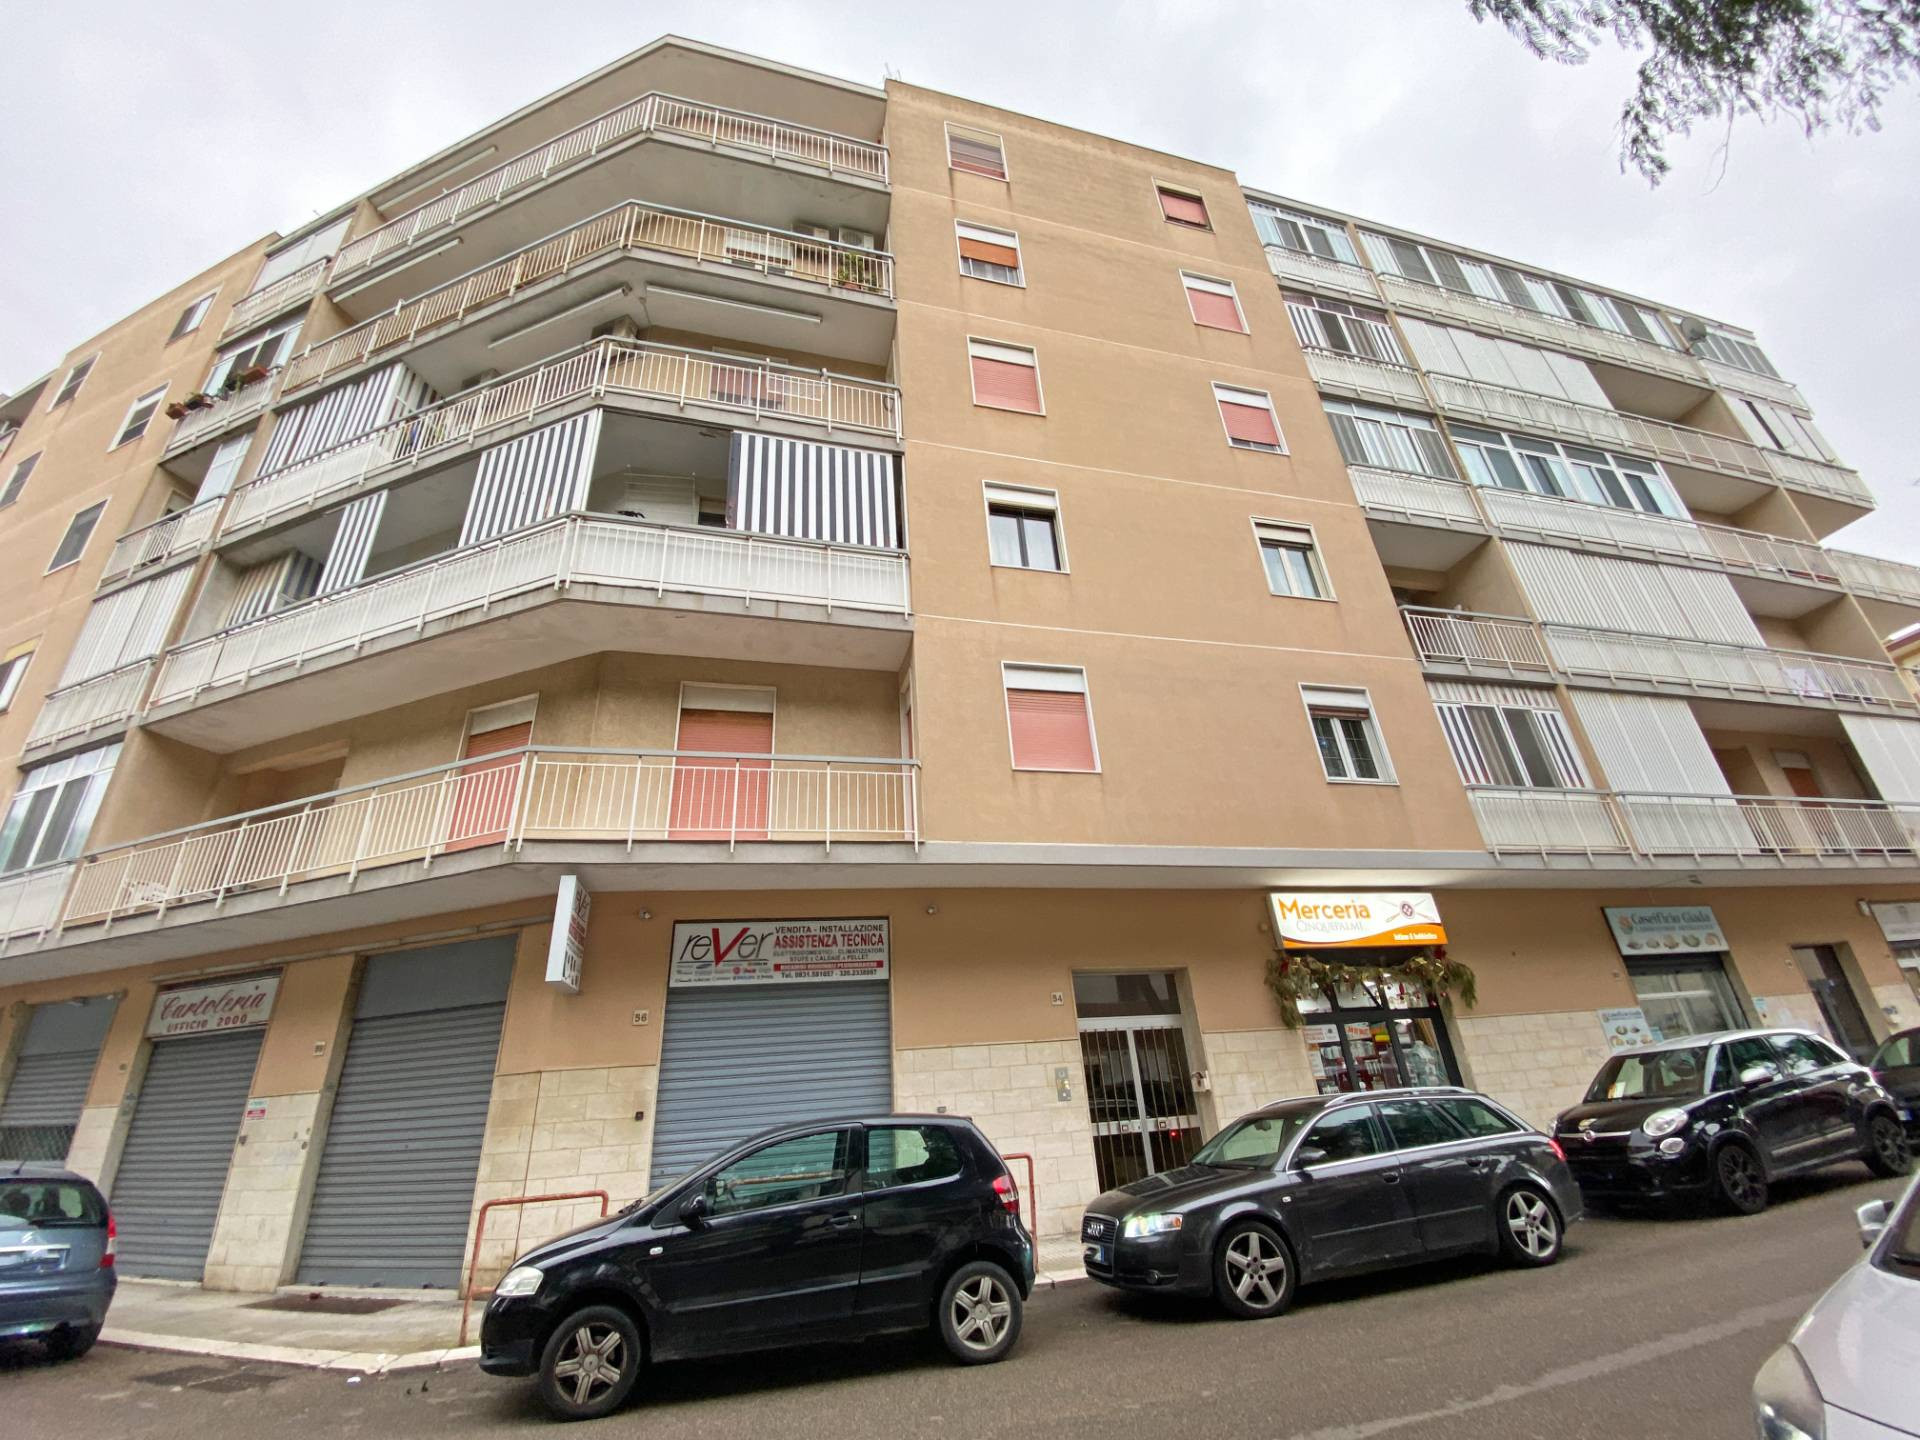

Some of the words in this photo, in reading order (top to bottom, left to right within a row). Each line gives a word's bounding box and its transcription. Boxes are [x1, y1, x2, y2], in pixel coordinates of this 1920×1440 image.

[1278, 897, 1371, 920] Merceria
[775, 926, 812, 934] VENDITA
[819, 924, 884, 933] INSTALLAZIONE
[774, 934, 838, 949] ASSISTENZA
[841, 933, 884, 947] TECNICA
[160, 984, 267, 1021] Cartoleria
[167, 1020, 208, 1033] UFFICIO
[216, 1014, 248, 1028] 2000
